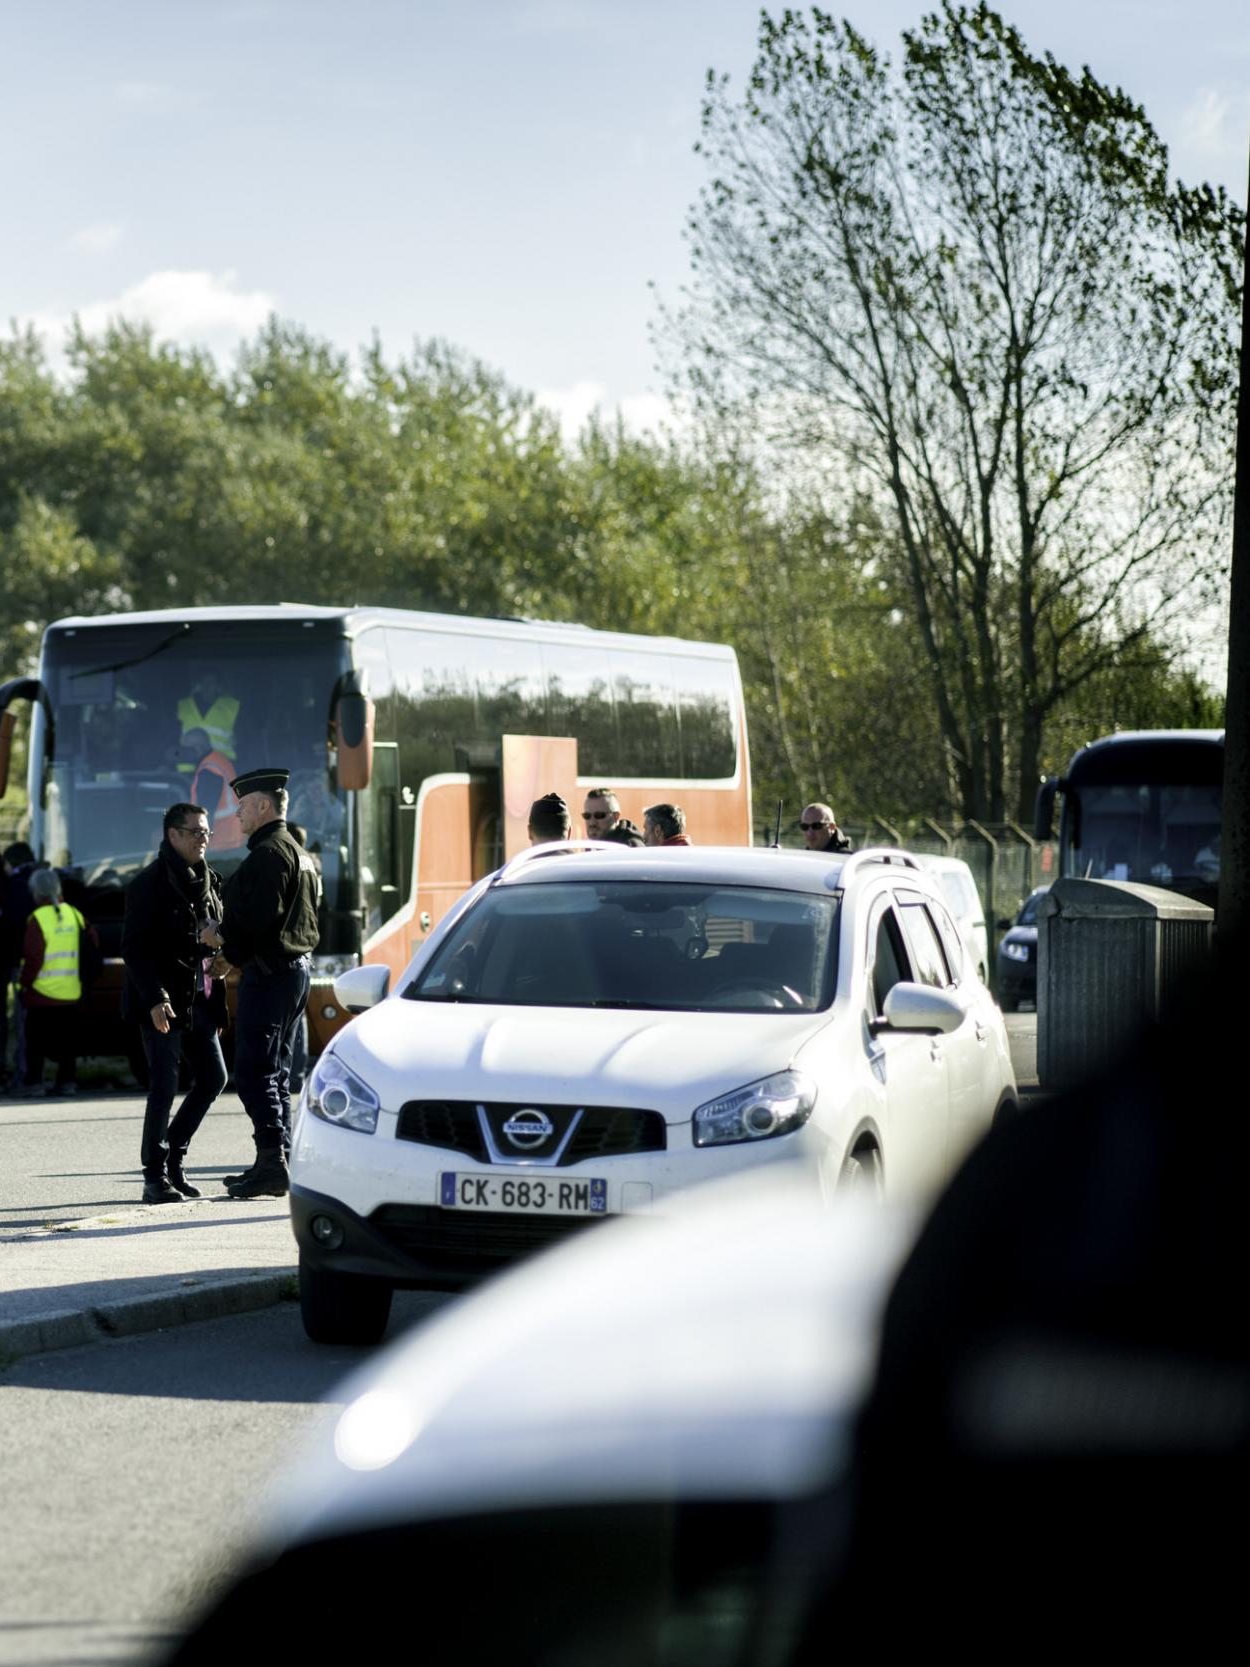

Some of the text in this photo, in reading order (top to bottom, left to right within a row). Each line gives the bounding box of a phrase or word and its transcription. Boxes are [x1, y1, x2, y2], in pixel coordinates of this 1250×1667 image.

[507, 1124, 547, 1132] NISSAN
[461, 1178, 589, 1210] CK-683-RM
[591, 1197, 605, 1210] 62
